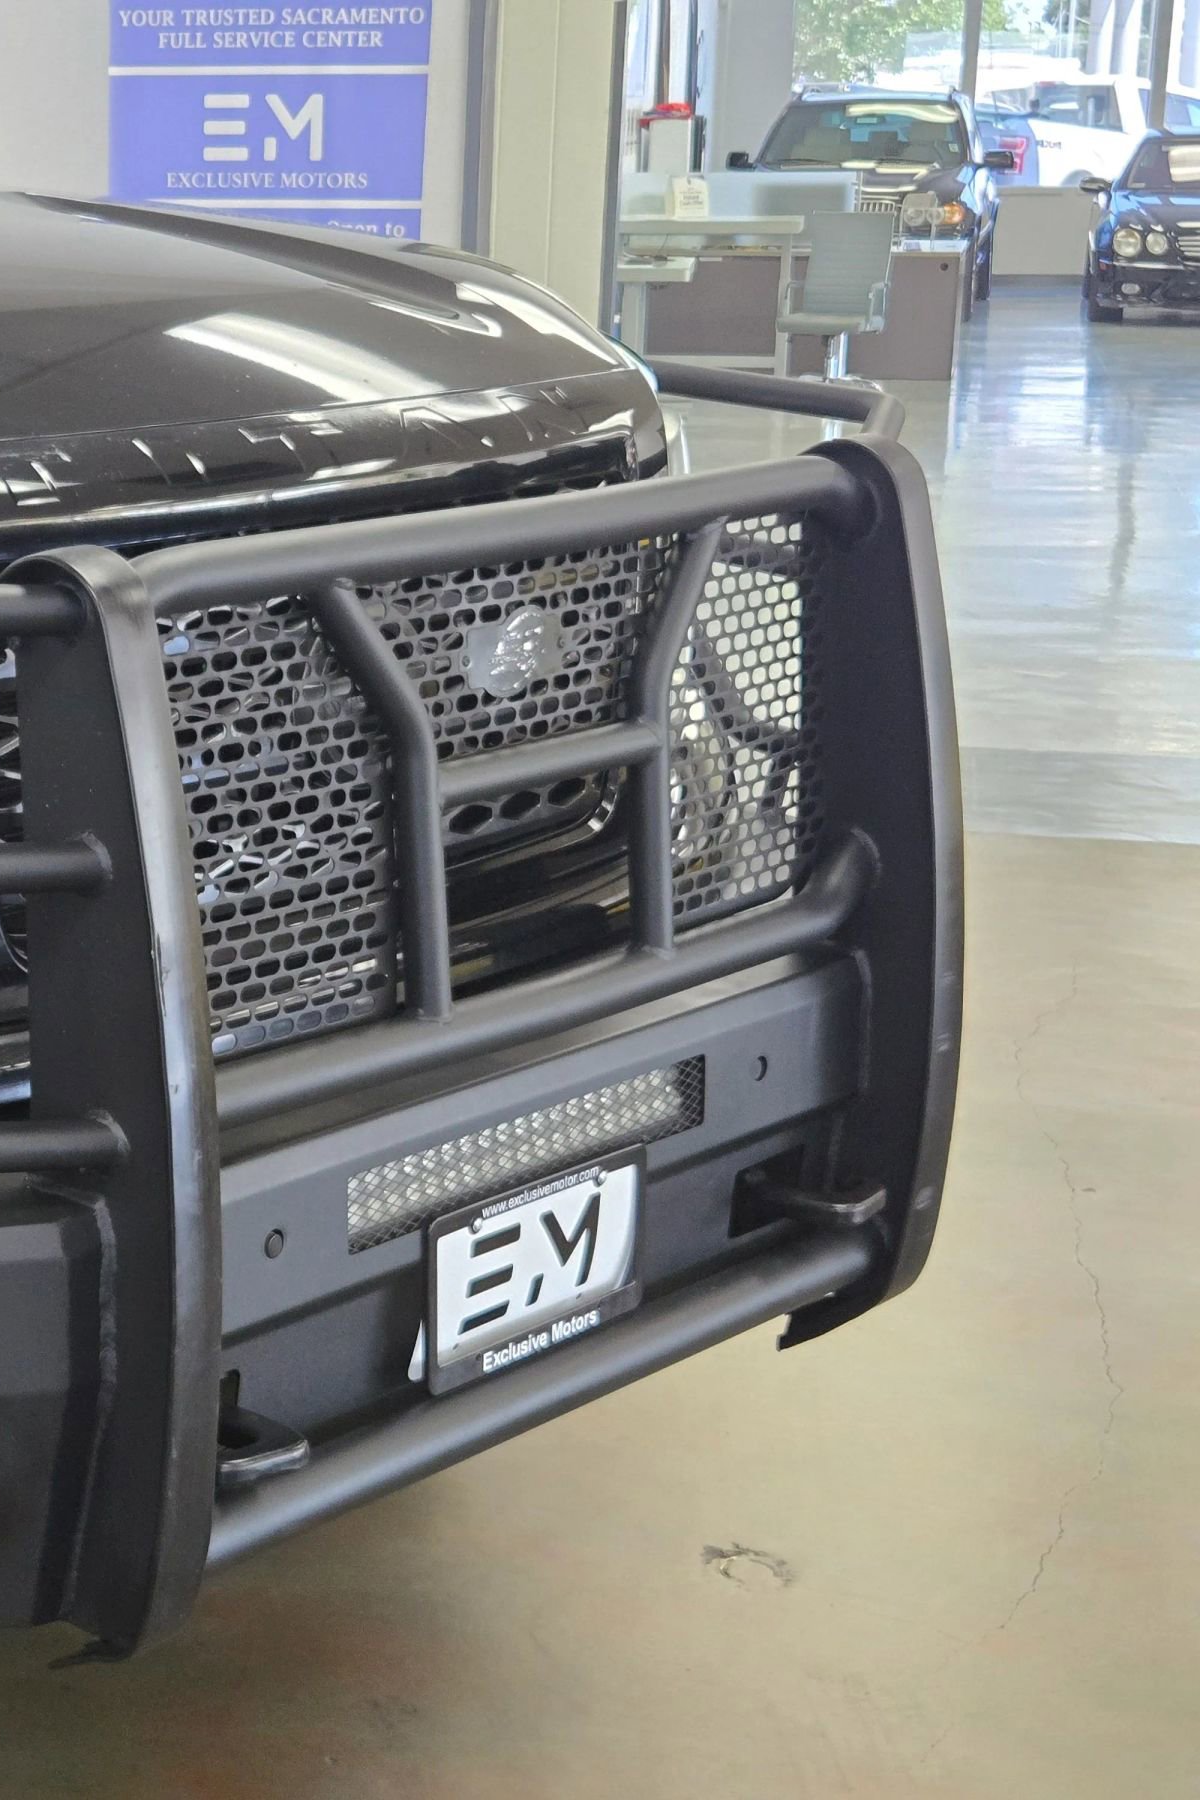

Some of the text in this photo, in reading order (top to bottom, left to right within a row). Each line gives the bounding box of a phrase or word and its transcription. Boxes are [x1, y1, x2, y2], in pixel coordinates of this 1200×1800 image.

[119, 7, 425, 27] YOUR TRUSTED SACRAMENTO
[158, 30, 384, 49] FULL SERVICE CENTER
[166, 172, 368, 189] EXCLUSIVE MOTORS
[385, 222, 406, 238] to
[481, 1165, 599, 1219] www.exclusivemotor.com
[482, 1309, 598, 1374] Exclusive Motors
